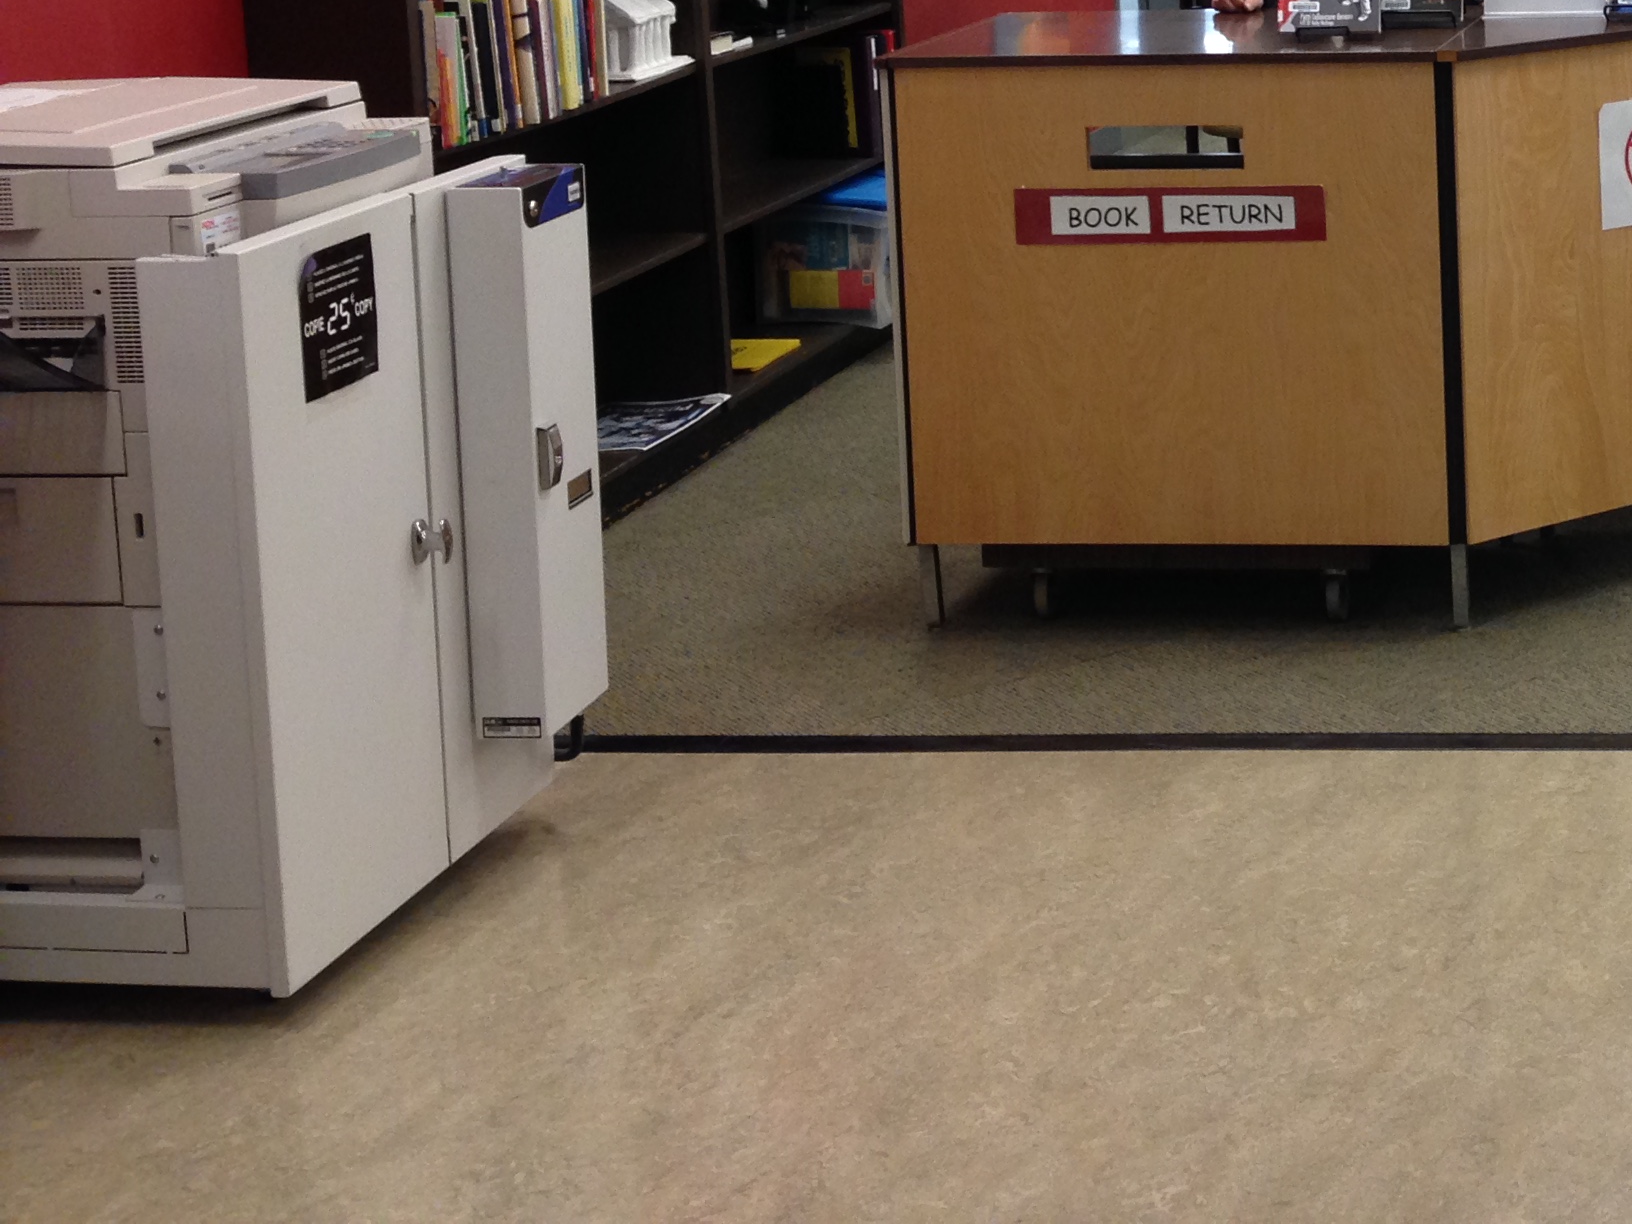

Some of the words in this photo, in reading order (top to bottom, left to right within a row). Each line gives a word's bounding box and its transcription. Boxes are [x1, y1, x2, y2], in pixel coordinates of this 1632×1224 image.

[1068, 207, 1139, 228] BOOK
[1180, 203, 1283, 225] RETURN
[354, 296, 374, 317] COPY
